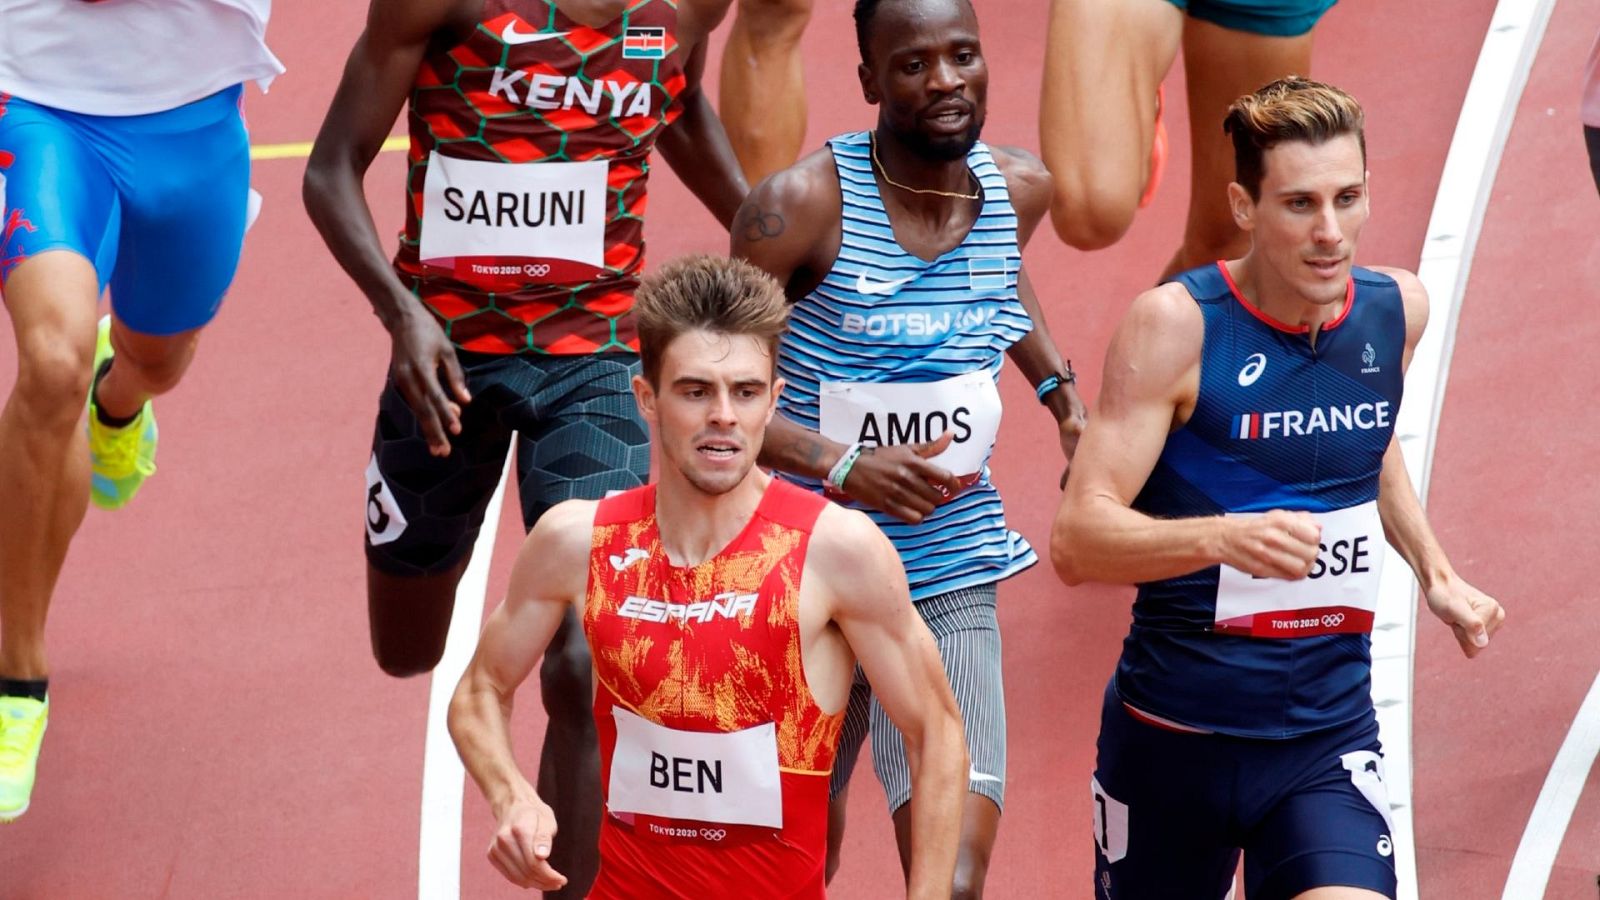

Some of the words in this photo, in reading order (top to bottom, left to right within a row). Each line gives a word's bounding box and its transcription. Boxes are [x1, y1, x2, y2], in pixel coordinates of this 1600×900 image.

[488, 66, 651, 118] KENYA
[443, 186, 585, 228] SARUNI
[472, 264, 499, 275] TOKYO
[500, 266, 521, 275] 2020
[858, 406, 972, 447] AMOS
[1262, 401, 1390, 439] FRANCE
[1251, 535, 1369, 580] SSE
[617, 591, 760, 624] ESPAÑA
[1272, 618, 1299, 630] TOKYO
[1299, 618, 1320, 628] 2020
[650, 751, 722, 793] BEN
[650, 823, 675, 836] TOKYO
[676, 827, 697, 838] 2020
